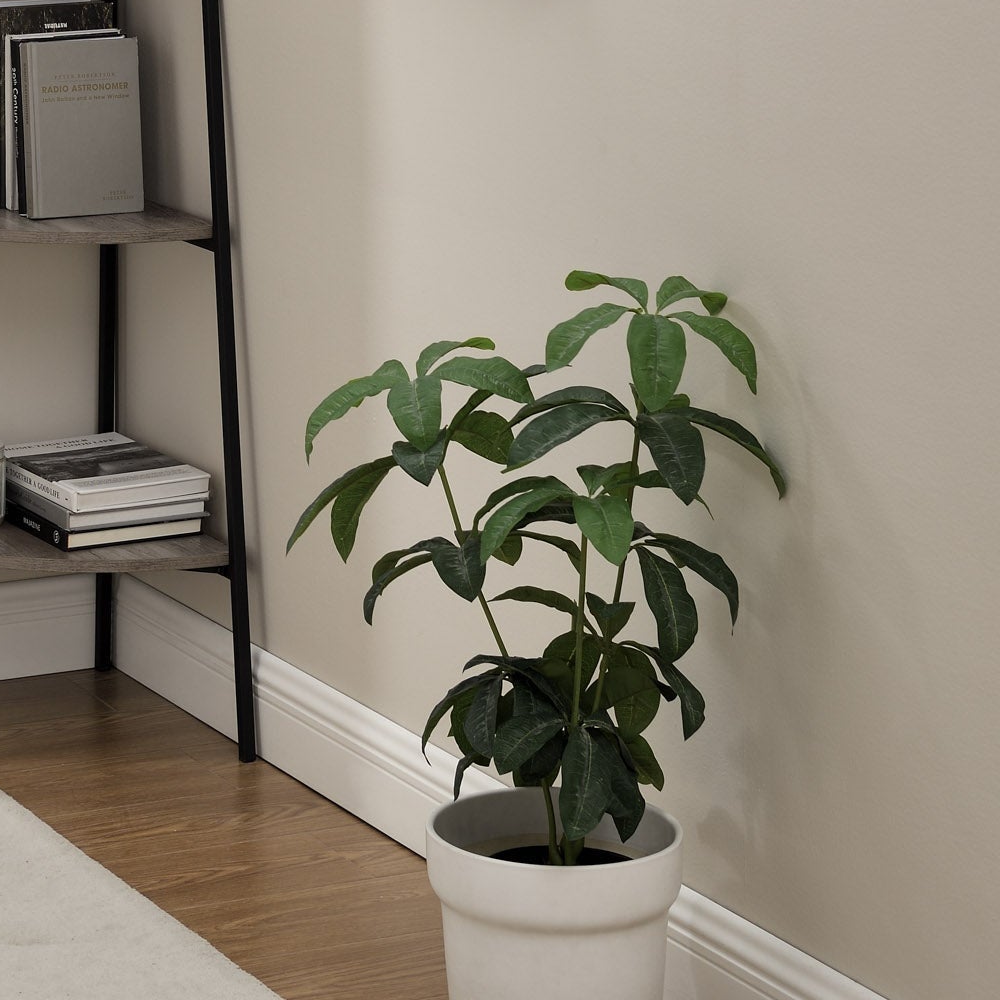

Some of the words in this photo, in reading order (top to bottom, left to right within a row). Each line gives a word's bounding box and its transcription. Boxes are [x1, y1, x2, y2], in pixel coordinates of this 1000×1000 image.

[41, 85, 69, 94] RADIO
[71, 82, 129, 92] ASTRONOMER
[10, 468, 32, 486] TOGETHER
[37, 482, 51, 495] GOOD
[51, 488, 60, 499] LIFE
